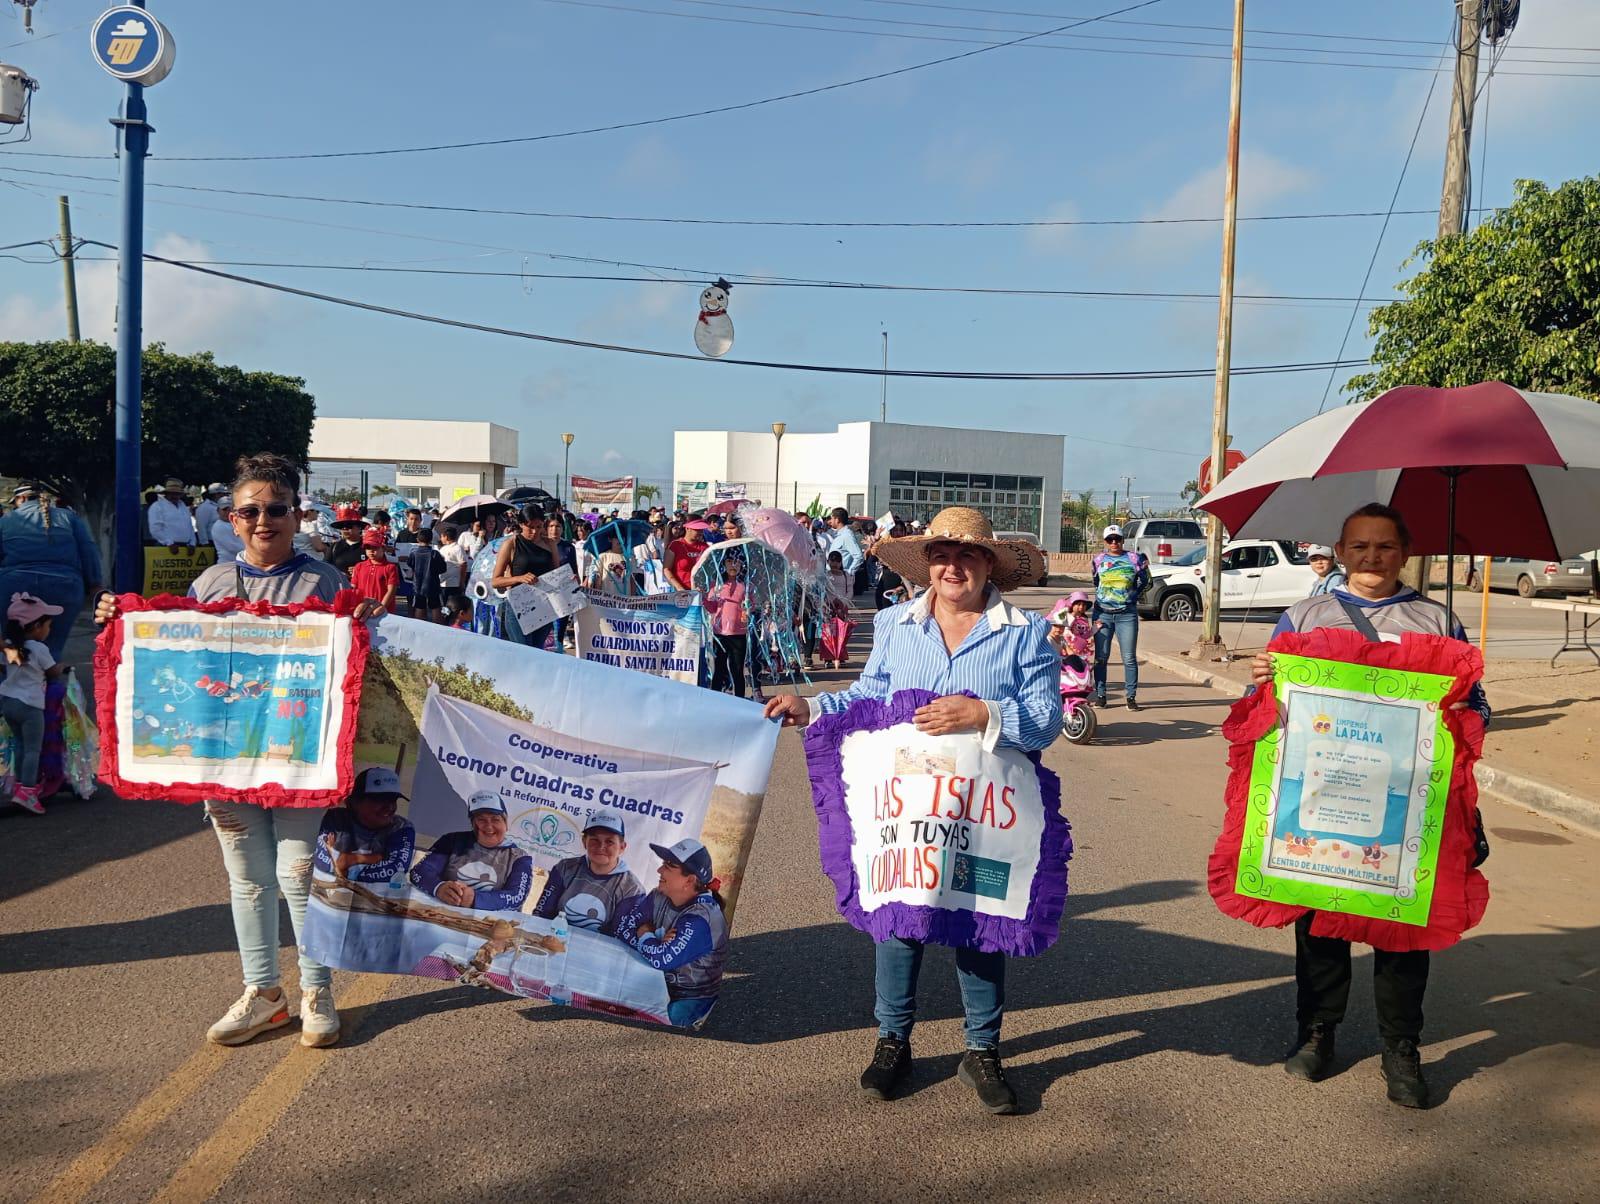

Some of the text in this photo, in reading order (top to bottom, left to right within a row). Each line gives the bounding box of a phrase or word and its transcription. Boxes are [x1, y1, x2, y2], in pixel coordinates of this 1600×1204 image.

[152, 559, 193, 568] NUESTRO
[152, 570, 187, 579] FUTURO
[151, 581, 162, 590] EN
[650, 622, 670, 635] LOS
[592, 635, 675, 654] GUARDIANES DE
[275, 661, 316, 680] MAR
[625, 656, 656, 670] SANTA
[660, 658, 694, 672] MARIA
[276, 699, 307, 720] NO
[1336, 719, 1368, 729] LIMPIEMOS
[1336, 727, 1383, 744] LA PLAYA
[508, 733, 618, 774] Cooperativa
[438, 746, 684, 825] Leonor Cuadras Cuadras
[500, 786, 511, 797] La
[514, 789, 558, 810] Reforma,
[560, 802, 582, 816] Ang.
[874, 774, 1017, 830] LAS ISLAS
[880, 820, 970, 850] SON TUYAS
[1271, 857, 1299, 868] CENTRO
[1301, 861, 1310, 869] DE
[663, 954, 673, 964] la
